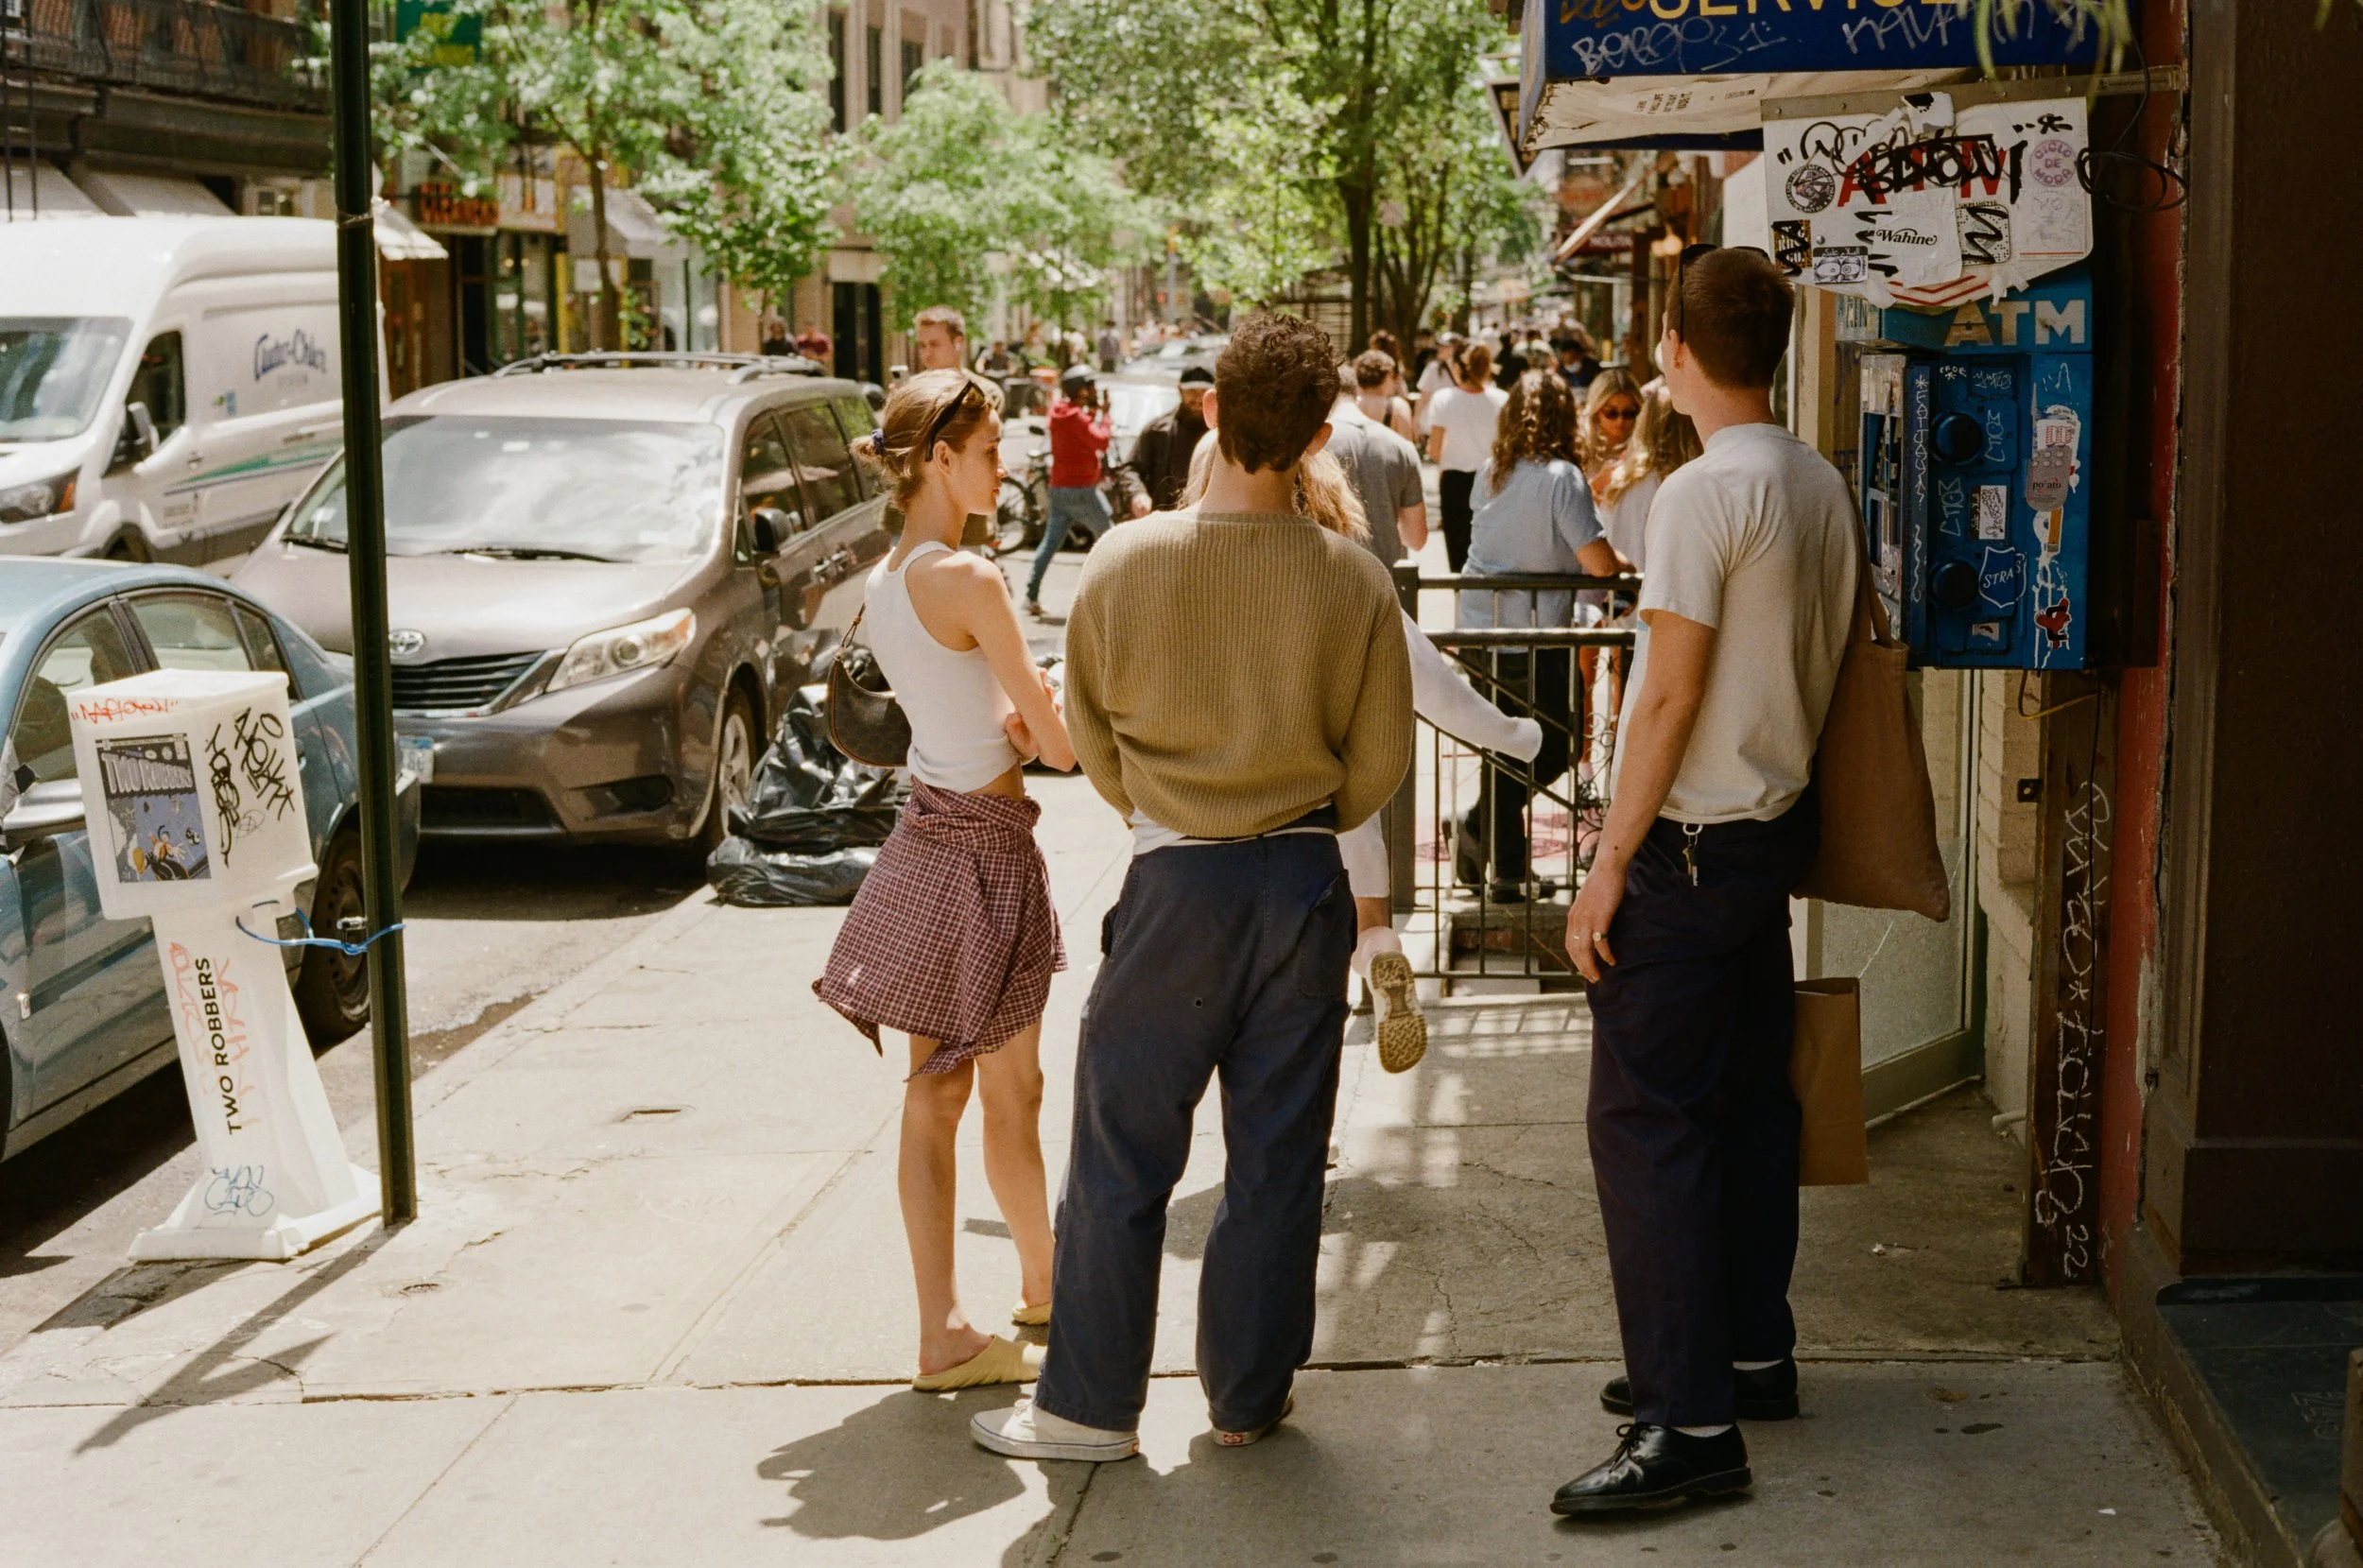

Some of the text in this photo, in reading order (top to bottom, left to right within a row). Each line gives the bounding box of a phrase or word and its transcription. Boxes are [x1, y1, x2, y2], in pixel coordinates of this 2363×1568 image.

[2035, 142, 2073, 160] CICLO
[2044, 159, 2061, 168] DE
[2034, 168, 2073, 184] MODA
[1876, 228, 1938, 246] Wahine
[1944, 300, 2085, 346] ATM
[2032, 480, 2061, 492] poato
[101, 751, 142, 795] TWO
[195, 957, 230, 1067] ROBBERS
[220, 1076, 243, 1135] TWO
